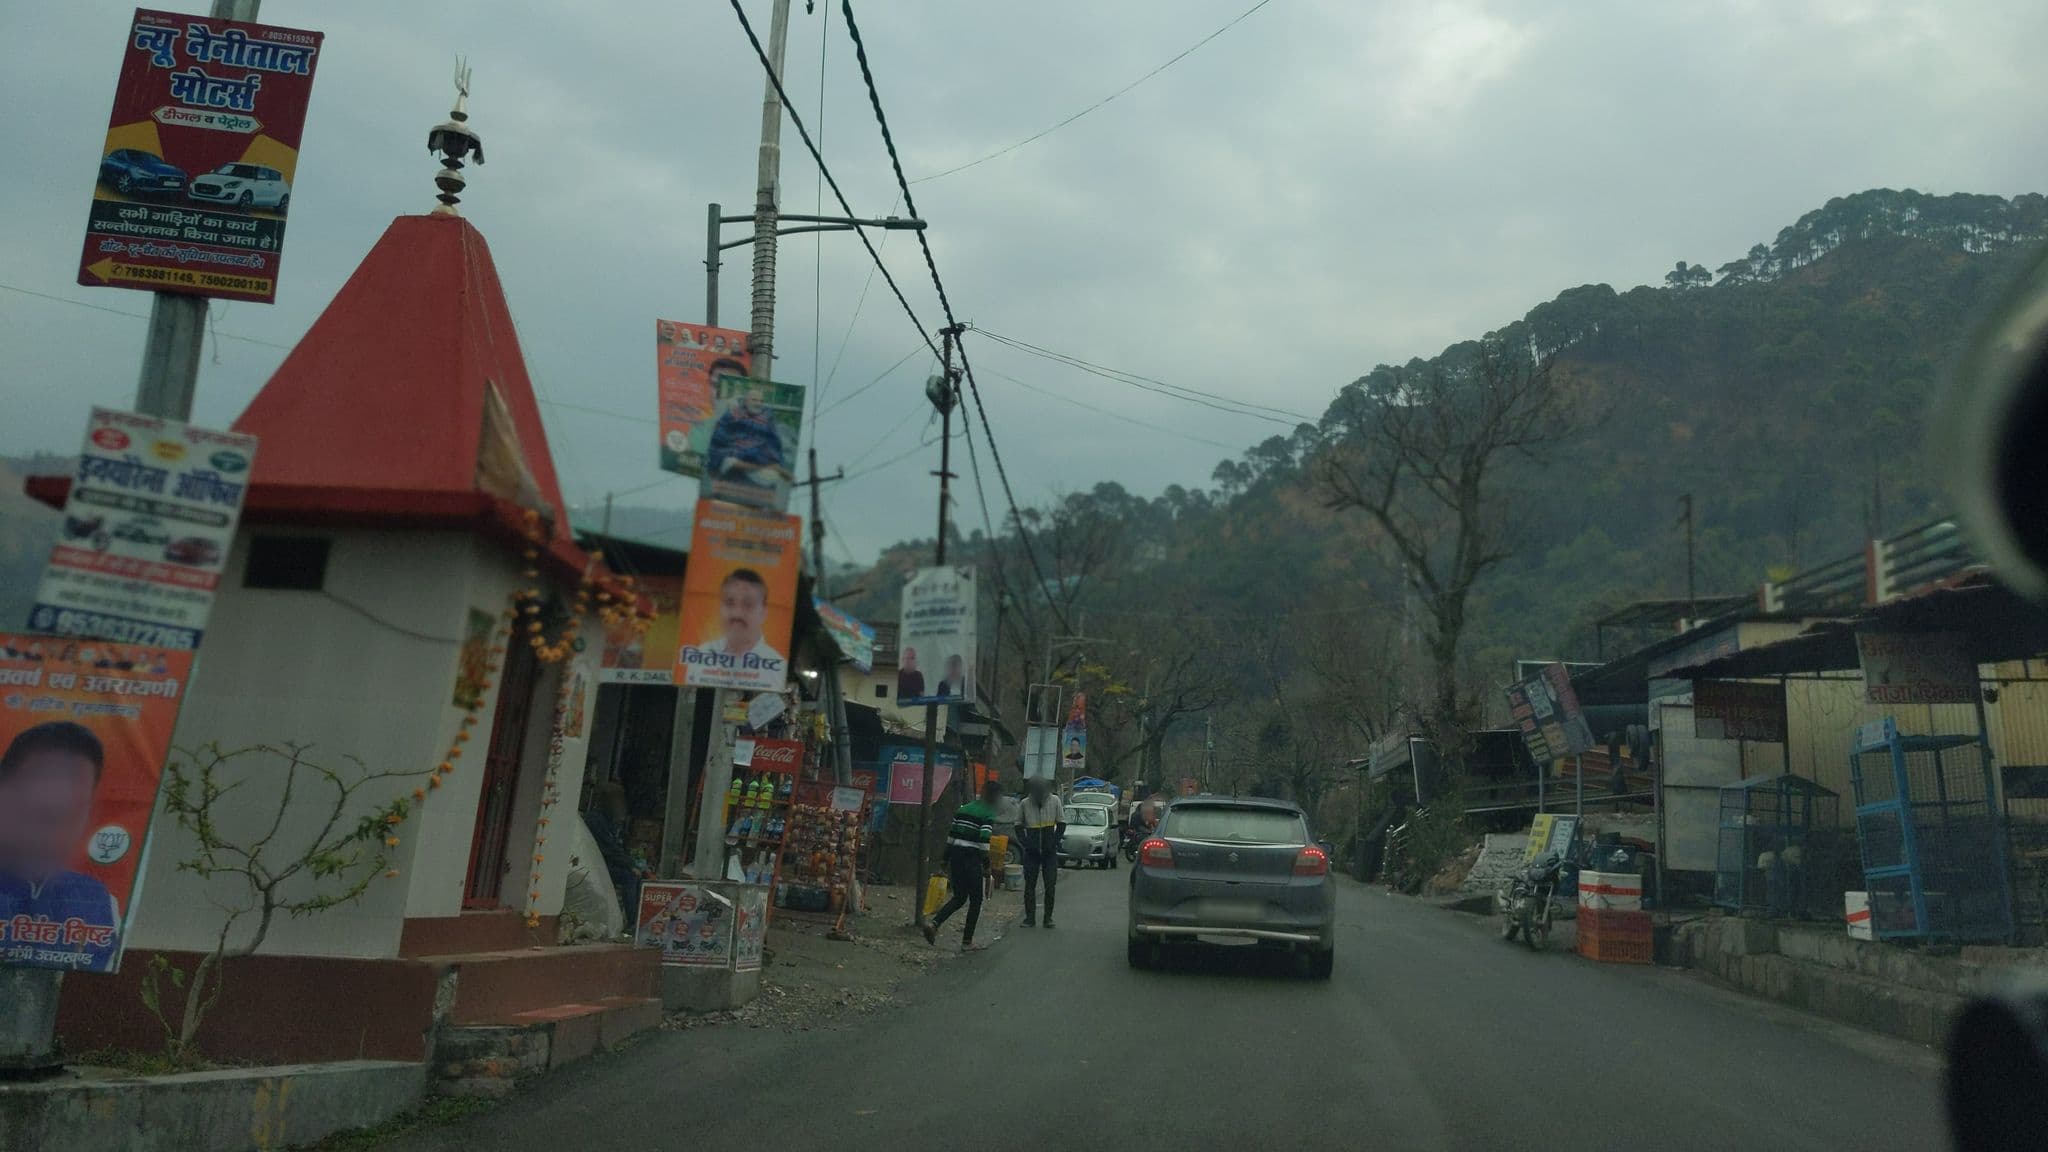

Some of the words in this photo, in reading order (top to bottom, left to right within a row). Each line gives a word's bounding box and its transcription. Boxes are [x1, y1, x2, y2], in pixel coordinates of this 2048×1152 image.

[134, 24, 182, 69] न्यू
[186, 23, 316, 75] नैनीताल
[170, 66, 262, 112] मोटर्स
[162, 108, 201, 123] डीजल
[204, 114, 215, 124] व
[217, 114, 252, 130] पेट्रोल
[93, 219, 180, 238] सन्तोषजनक
[183, 227, 217, 242] किया
[221, 234, 257, 247] जाता
[119, 207, 148, 220] सभी
[151, 210, 202, 228] गाड़ियों
[202, 218, 223, 229] का
[226, 219, 258, 232] कार्य
[681, 645, 736, 668] नितेश
[743, 652, 785, 672] बिष्ट
[894, 752, 908, 761] Jio
[11, 914, 61, 944] सिंह
